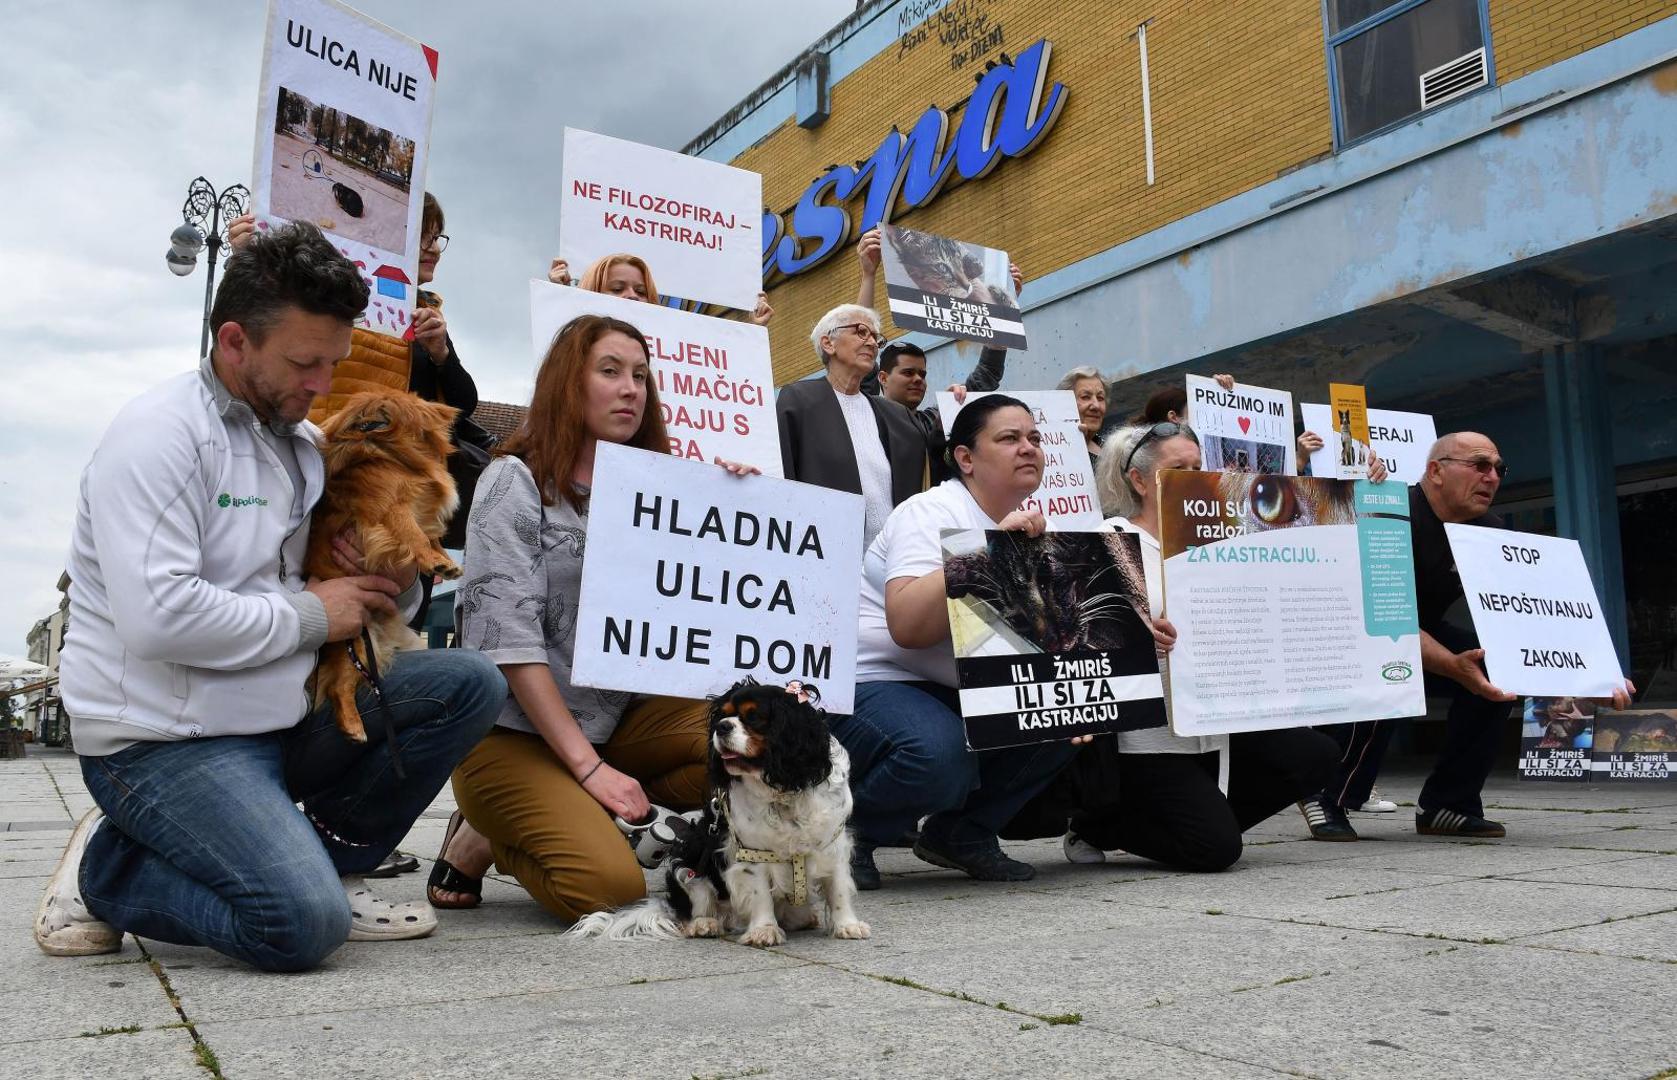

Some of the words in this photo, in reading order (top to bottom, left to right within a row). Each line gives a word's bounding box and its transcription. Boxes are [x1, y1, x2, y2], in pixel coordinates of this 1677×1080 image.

[286, 20, 361, 77] ULICA
[368, 50, 418, 101] NIJE
[573, 179, 602, 200] NE
[608, 187, 736, 229] FILOZOFIRAJ
[604, 212, 723, 252] KASTRIRAJ!
[922, 294, 938, 306] ILI
[949, 297, 990, 316] ŽMIRIŠ
[924, 305, 945, 320] ILI
[949, 310, 965, 324] SI
[970, 314, 993, 328] ZA
[926, 319, 994, 339] KASTRACIJU
[672, 373, 764, 407] MAČIĆI
[1195, 388, 1265, 414] PRUŽIMO
[1268, 401, 1285, 418] IM
[733, 413, 751, 436] S
[1368, 426, 1414, 443] ERAJI
[1040, 471, 1068, 489] VAŠI
[1070, 473, 1085, 487] SU
[1048, 494, 1093, 517] ADUTI
[1183, 499, 1220, 518] KOJI
[1225, 500, 1248, 518] SU
[632, 491, 825, 560] HLADNA
[1186, 546, 1211, 563] ZA
[1501, 544, 1541, 566] STOP
[655, 559, 797, 615] ULICA
[1478, 591, 1595, 620] NEPOŠTIVANJU
[603, 616, 712, 665] NIJE
[734, 633, 833, 680] DOM
[1520, 648, 1587, 670] ZAKONA
[1010, 663, 1034, 684] ILI
[1053, 652, 1113, 680] ŽMIRIŠ
[1014, 684, 1045, 710] ILI
[1053, 682, 1075, 707] SI
[1084, 678, 1117, 703] ZA
[1017, 704, 1120, 731] KASTRACIJU
[1525, 759, 1541, 769] ILI
[1546, 759, 1559, 769] SI
[1564, 759, 1583, 769] ZA
[1526, 751, 1539, 759] ILI
[1549, 749, 1585, 759] ŽMIRIŠ
[1610, 754, 1623, 762] ILI
[1634, 752, 1669, 762] ŽMIRIŠ
[1524, 769, 1583, 777] KASTRACIJU
[1610, 762, 1626, 771] ILI
[1631, 762, 1644, 771] SI
[1649, 762, 1668, 771] ZA
[1610, 770, 1669, 778] KASTRACIJU
